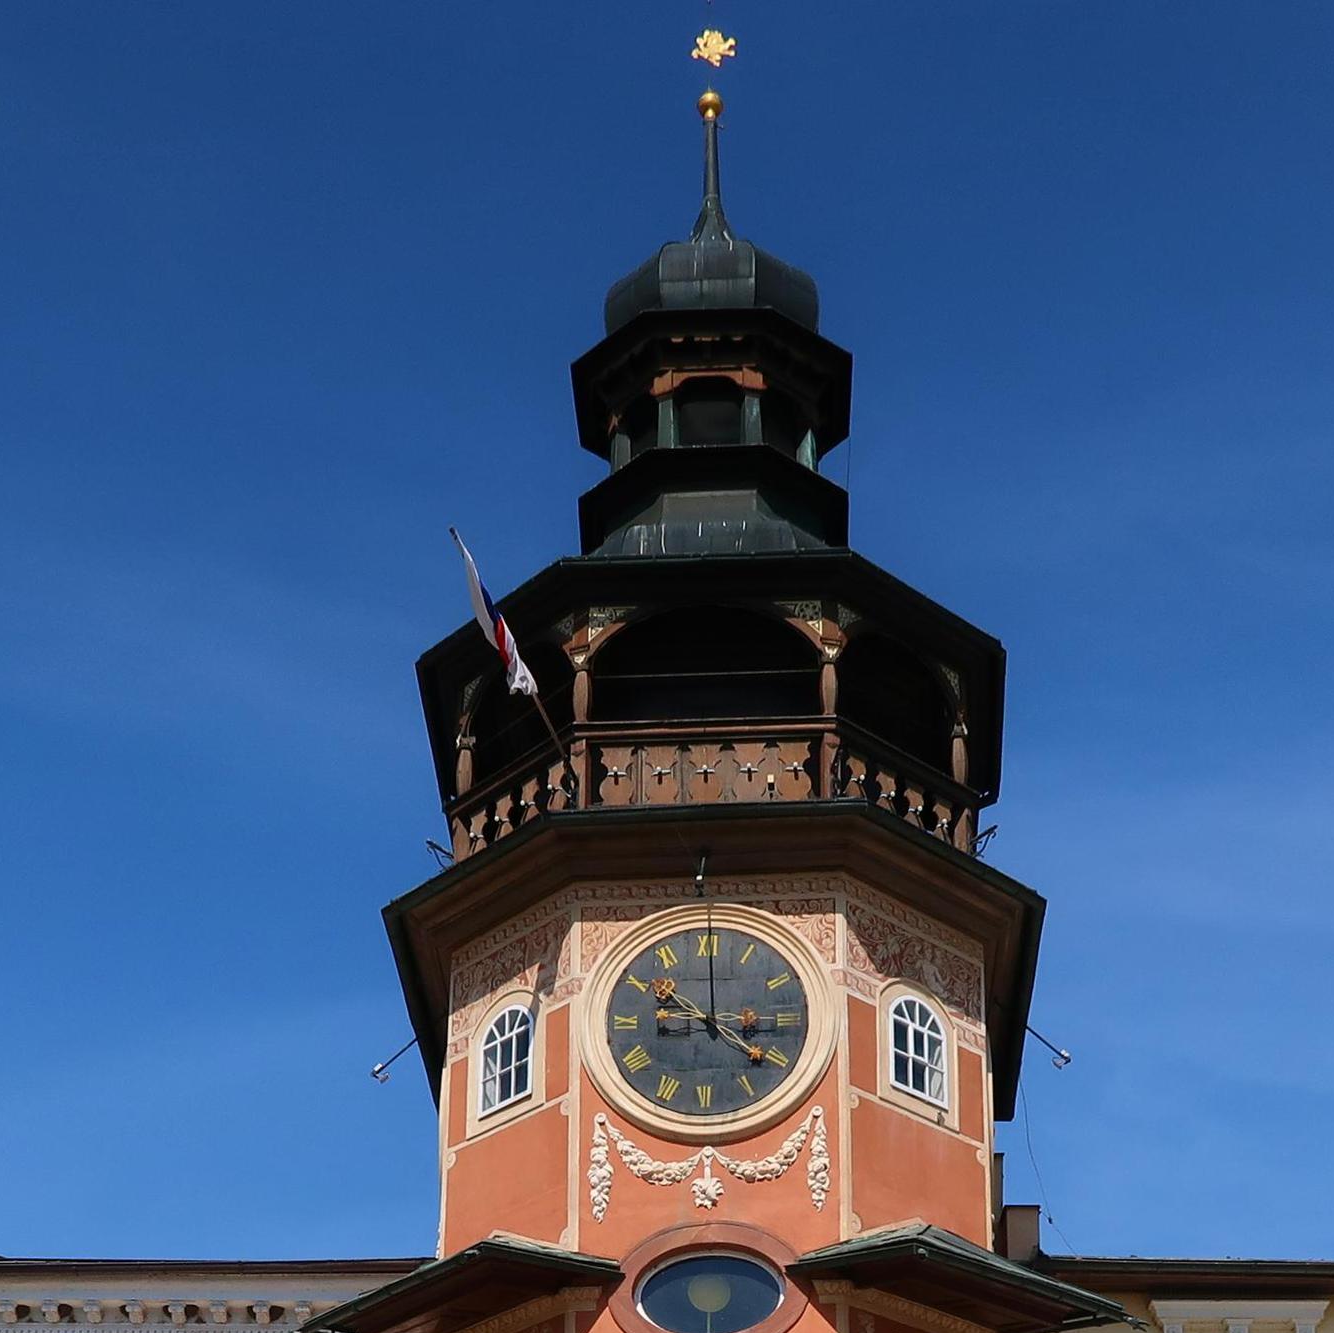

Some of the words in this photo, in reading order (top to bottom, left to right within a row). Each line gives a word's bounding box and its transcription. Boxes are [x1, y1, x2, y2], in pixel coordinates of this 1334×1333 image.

[656, 945, 678, 968] XI
[741, 945, 754, 964] I
[626, 975, 649, 992] X
[767, 973, 790, 990] II
[614, 1015, 638, 1029] IX
[777, 1014, 801, 1027] III
[623, 1045, 651, 1073] VIII
[765, 1047, 789, 1067] IV
[656, 1076, 680, 1100] VII
[696, 1085, 712, 1107] VI
[737, 1076, 754, 1096] V
